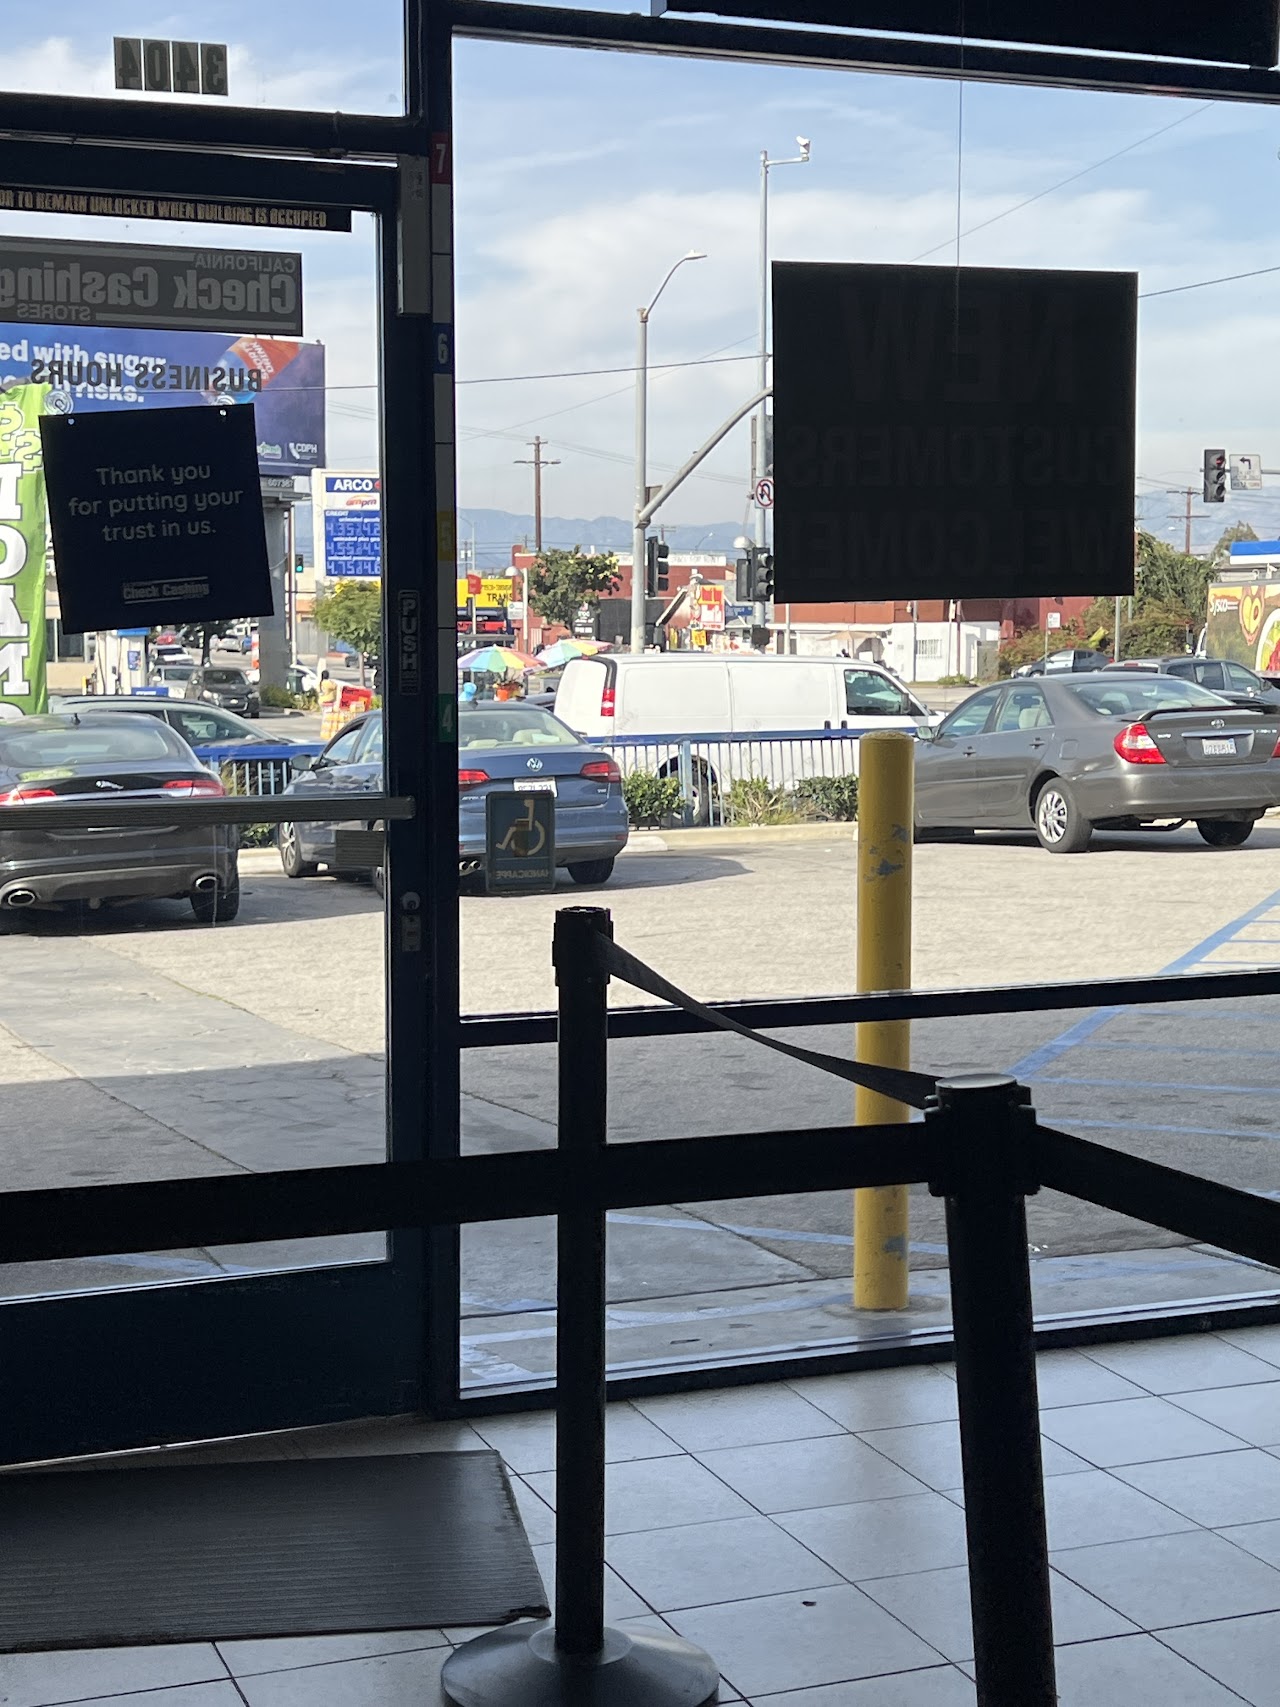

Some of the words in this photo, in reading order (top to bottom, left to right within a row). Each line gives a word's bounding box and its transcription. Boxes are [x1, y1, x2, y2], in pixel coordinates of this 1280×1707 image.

[436, 143, 447, 174] 7
[18, 191, 34, 208] TO
[36, 192, 87, 212] REMAIN
[89, 196, 155, 216] UNLOCKED
[157, 200, 195, 220] WHEN
[197, 203, 253, 224] BUILDING
[254, 207, 268, 224] IS
[269, 208, 328, 228] OCCUPIED
[96, 464, 165, 486] Thank
[171, 465, 211, 485] you
[333, 479, 373, 492] ARCO
[68, 497, 103, 517] for
[109, 493, 188, 518] putting
[194, 490, 244, 512] your
[102, 522, 156, 542] trust
[161, 520, 181, 537] in
[187, 519, 217, 535] us.
[123, 586, 160, 601] Check
[402, 599, 417, 669] PUSH
